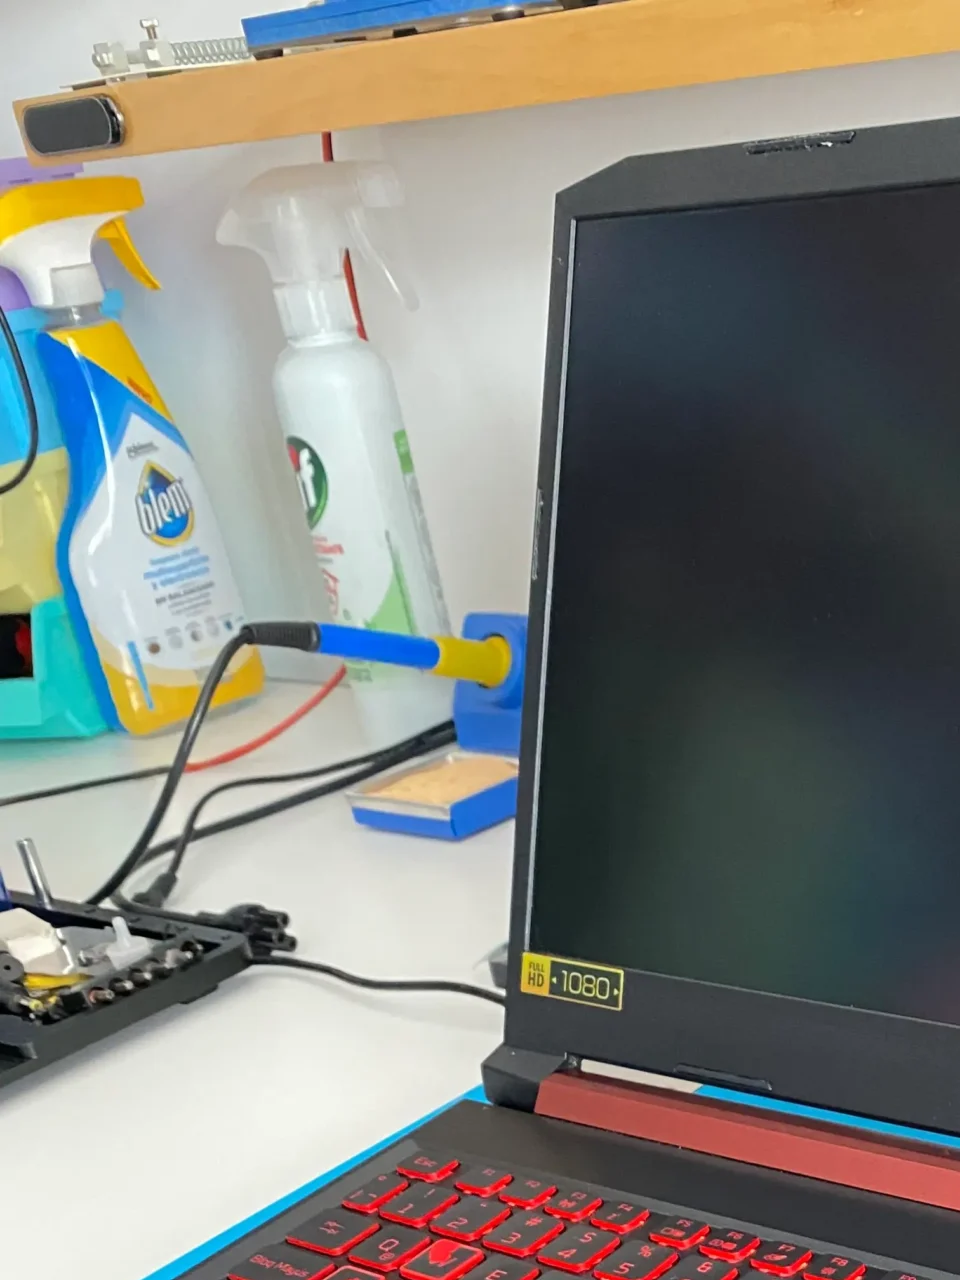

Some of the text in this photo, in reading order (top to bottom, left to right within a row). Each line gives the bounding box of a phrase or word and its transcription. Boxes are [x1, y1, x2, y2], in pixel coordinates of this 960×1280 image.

[135, 478, 193, 537] blem
[528, 961, 545, 973] FULL
[527, 971, 545, 987] HD
[562, 970, 610, 1000] 1080
[447, 1217, 468, 1229] 2
[378, 1238, 400, 1251] Q
[501, 1232, 522, 1244] 3
[558, 1249, 577, 1259] 4
[613, 1262, 635, 1275] 5
